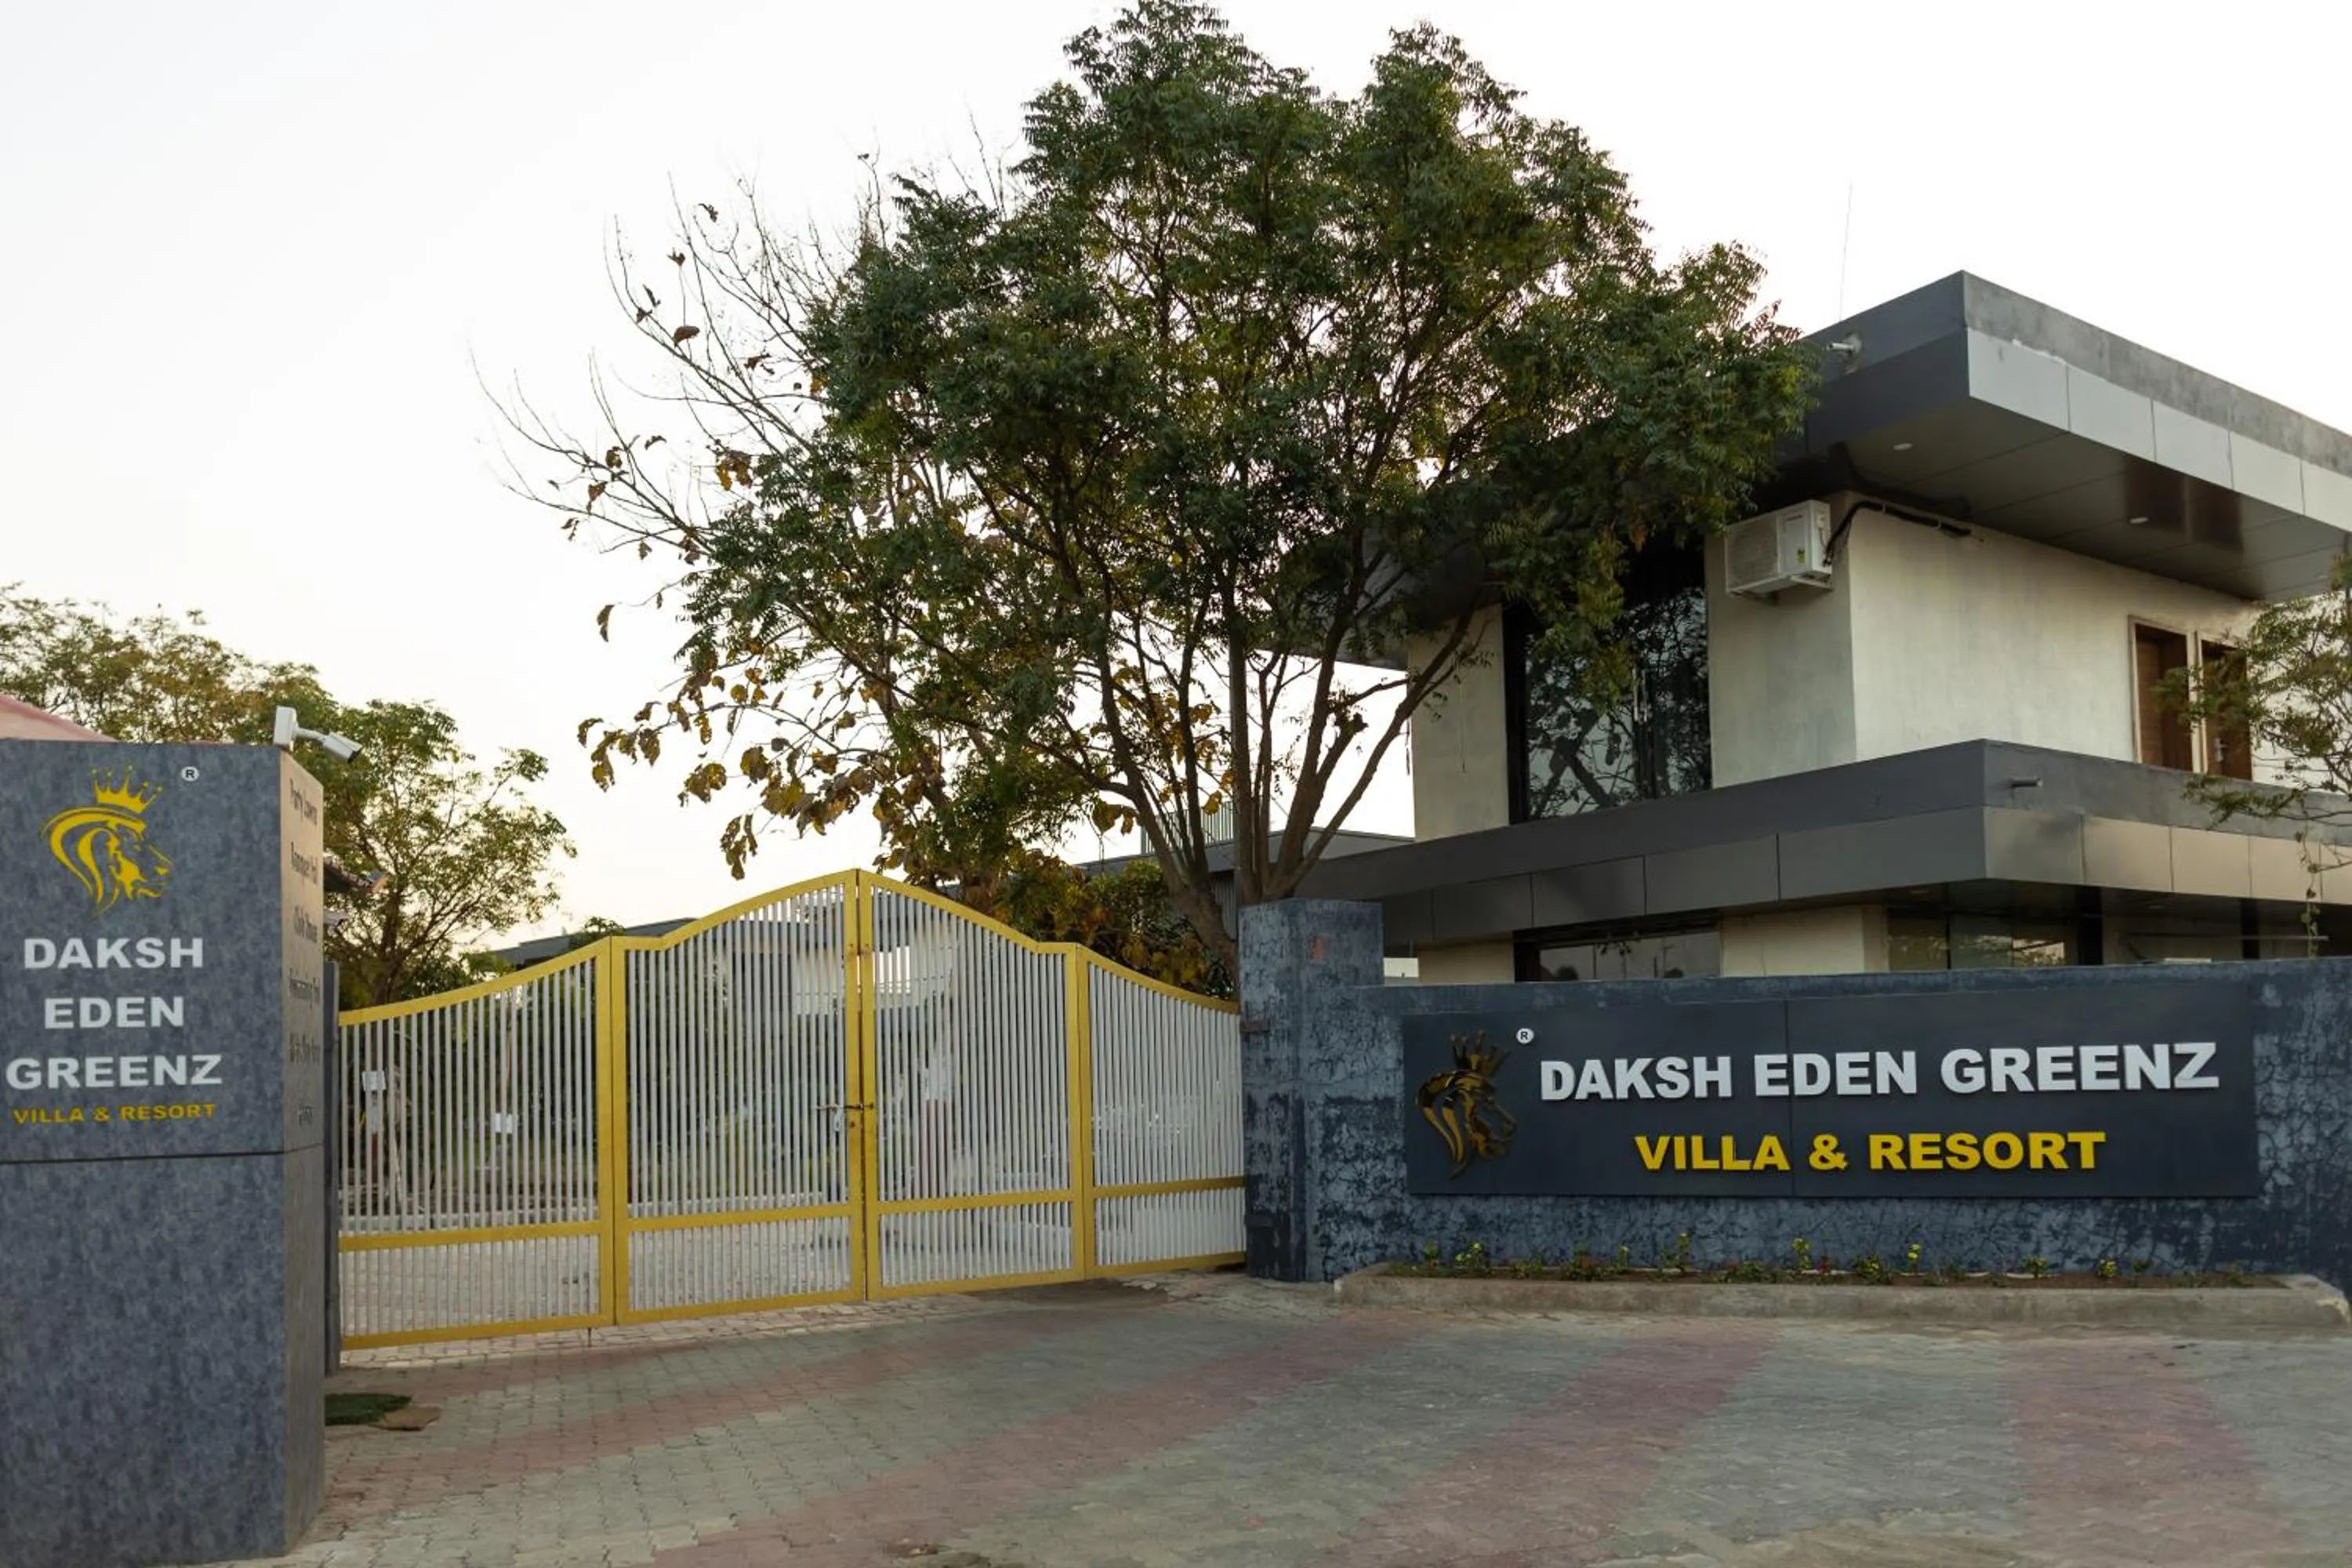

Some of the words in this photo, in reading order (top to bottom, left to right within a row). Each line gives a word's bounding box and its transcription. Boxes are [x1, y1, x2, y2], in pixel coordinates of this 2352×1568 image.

[24, 938, 202, 968] DAKSH
[45, 996, 183, 1029] EDEN
[6, 1054, 222, 1089] GREENZ
[1541, 1057, 1731, 1099] DAKSH
[1755, 1051, 1916, 1095] EDEN
[1941, 1043, 2219, 1092] GREENZ
[13, 1106, 85, 1123] VILLA
[93, 1107, 111, 1122] &
[118, 1103, 216, 1120] RESORT
[1635, 1134, 1791, 1171] VILLA
[1808, 1134, 1847, 1171] &
[1868, 1131, 2107, 1171] RESORT
